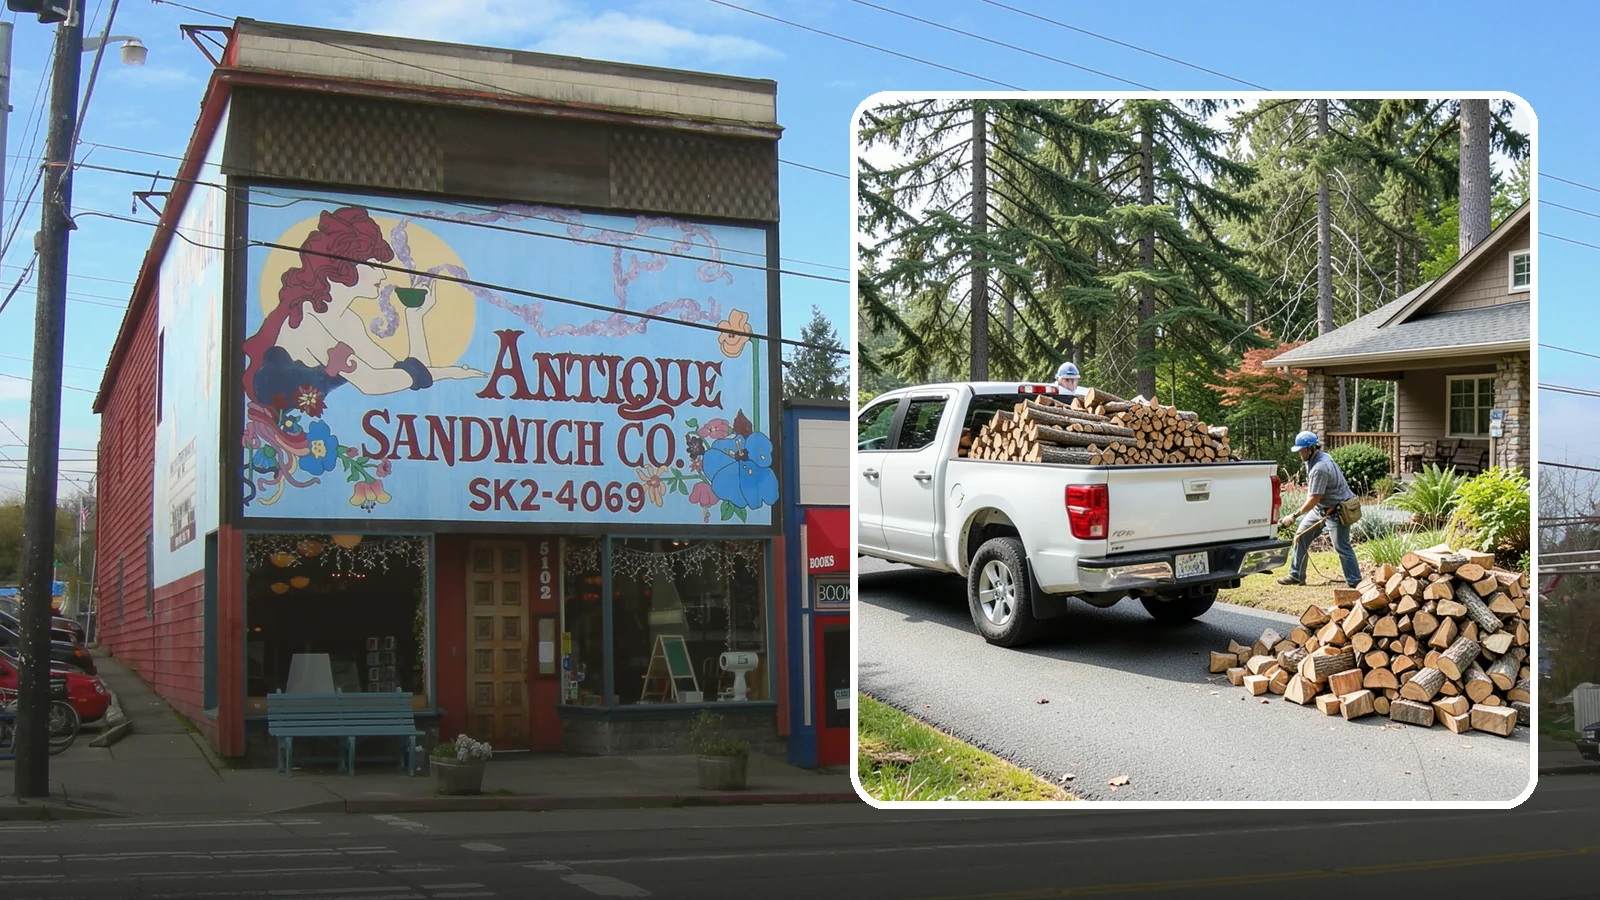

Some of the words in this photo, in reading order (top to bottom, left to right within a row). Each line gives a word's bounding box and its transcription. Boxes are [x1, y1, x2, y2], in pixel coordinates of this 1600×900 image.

[475, 329, 724, 421] ANTIQUE
[361, 408, 604, 467] SANDWICH
[617, 422, 685, 469] CO.
[468, 477, 646, 513] SK2-4069
[539, 541, 551, 599] 5102
[809, 554, 835, 569] BOOKS
